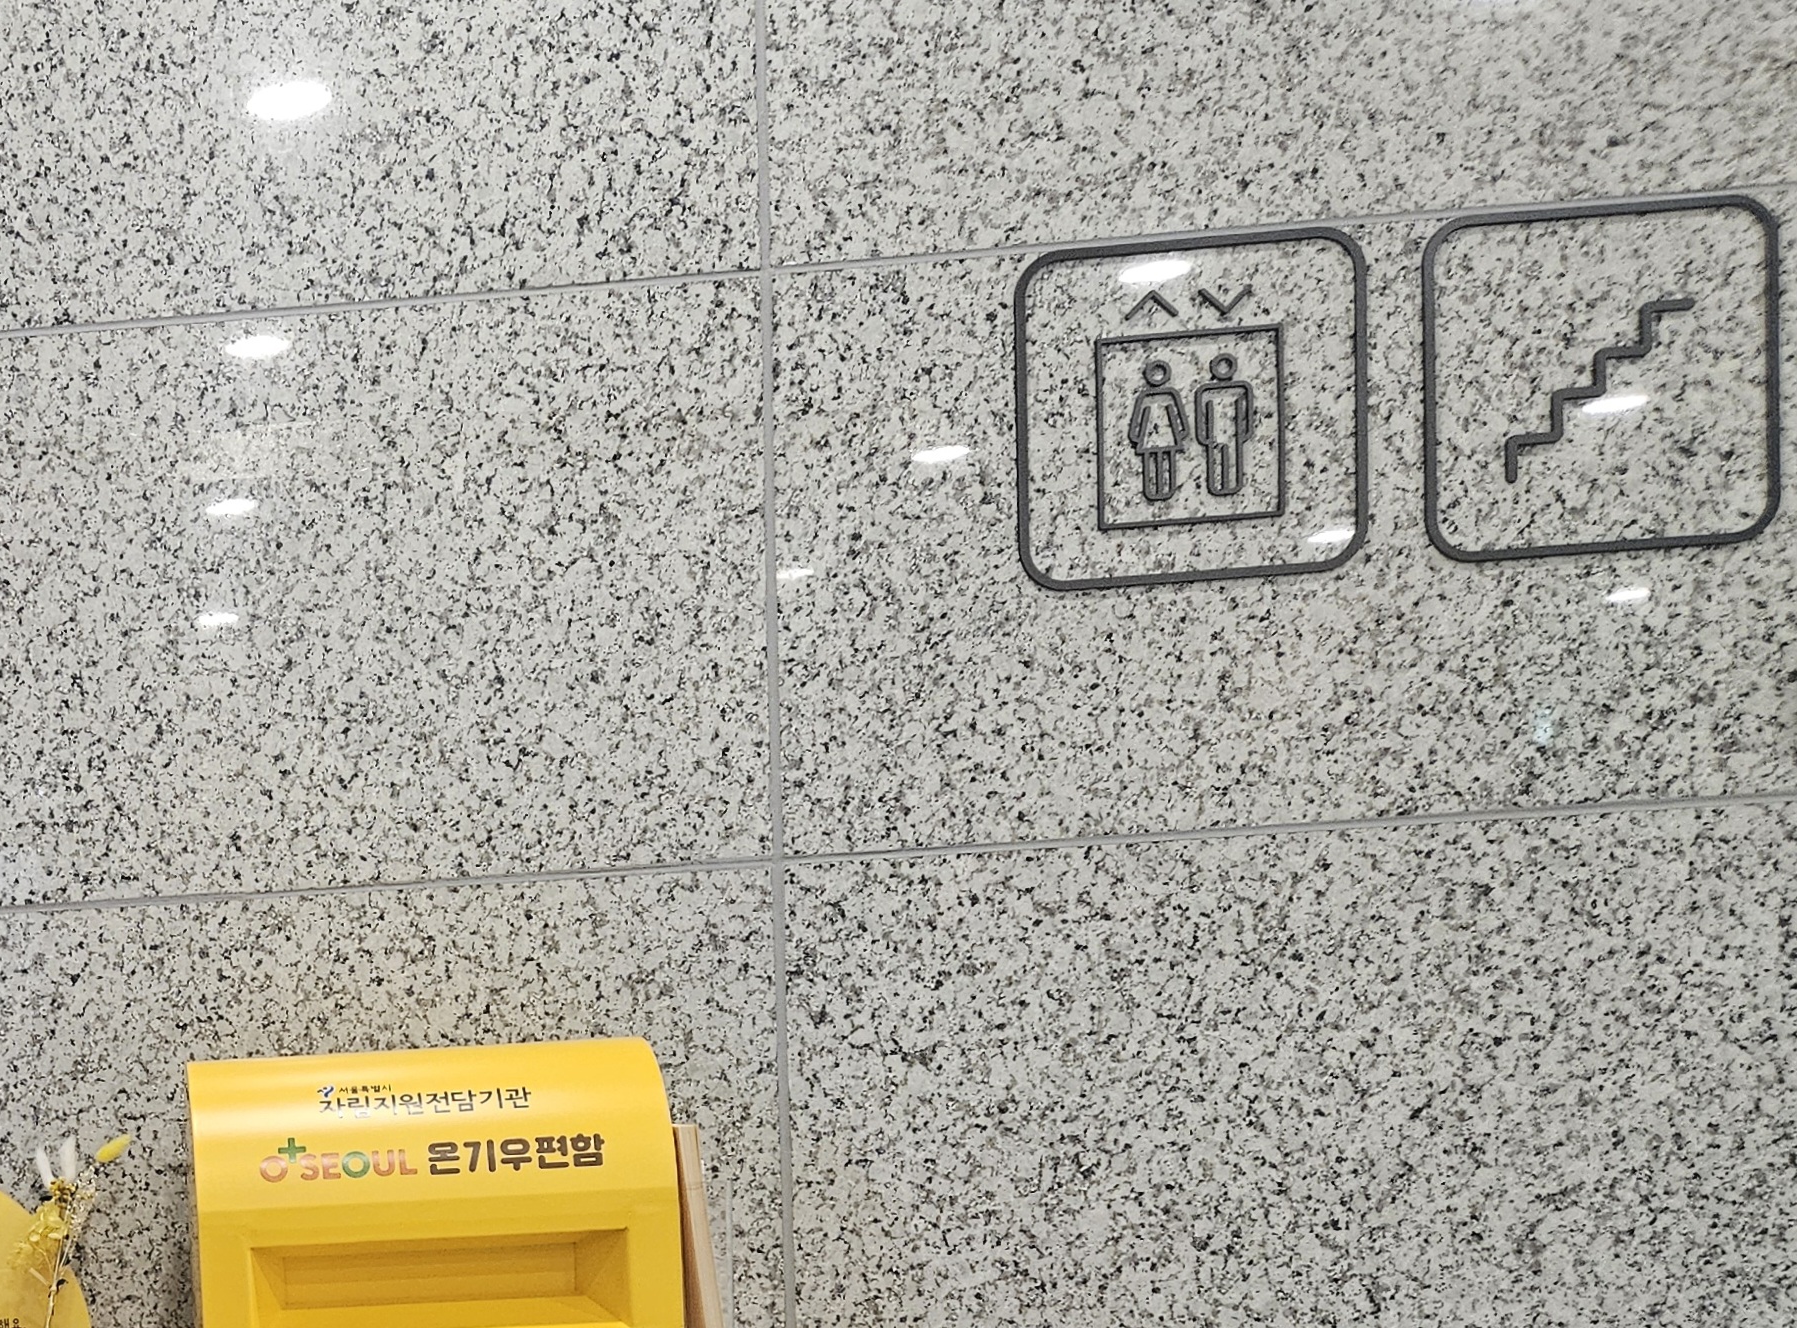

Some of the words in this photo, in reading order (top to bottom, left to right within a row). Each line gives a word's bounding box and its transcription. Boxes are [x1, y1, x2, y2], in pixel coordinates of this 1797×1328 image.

[319, 1086, 532, 1119] 자립지원전담기관
[338, 1083, 392, 1095] 서울특별시
[427, 1132, 606, 1176] 온기우편함
